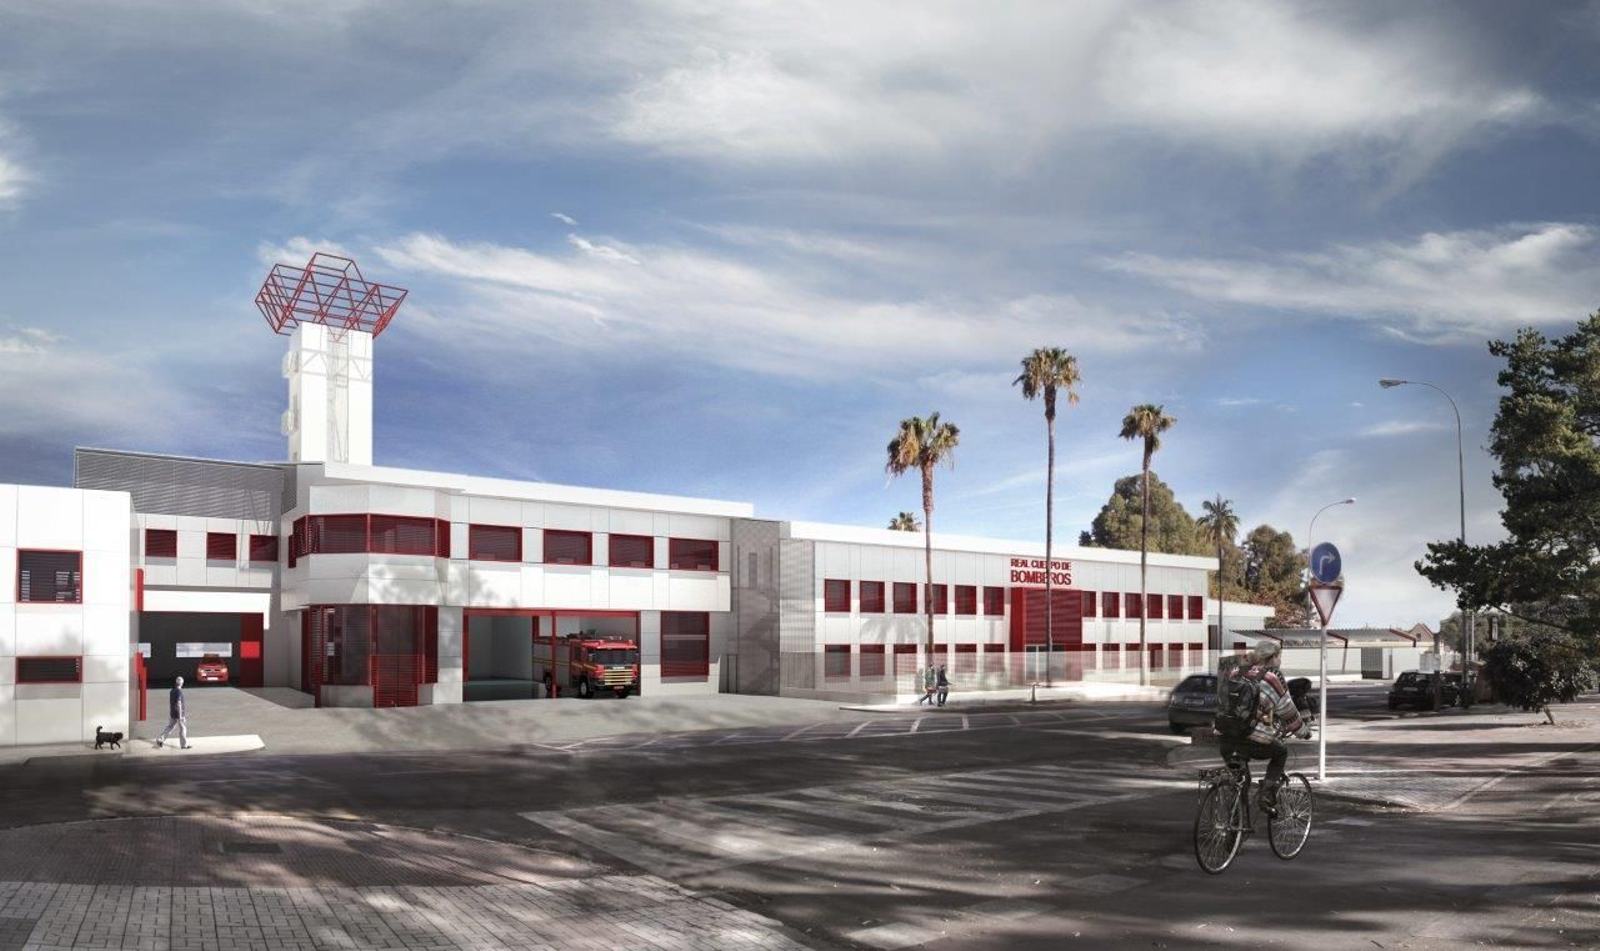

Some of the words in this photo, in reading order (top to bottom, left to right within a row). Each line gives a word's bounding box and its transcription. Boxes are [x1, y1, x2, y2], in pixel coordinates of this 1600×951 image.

[1010, 558, 1030, 568] REAL
[1031, 560, 1061, 570] CUEPO
[1061, 562, 1071, 570] DE
[1010, 569, 1072, 585] BOMBEROS
